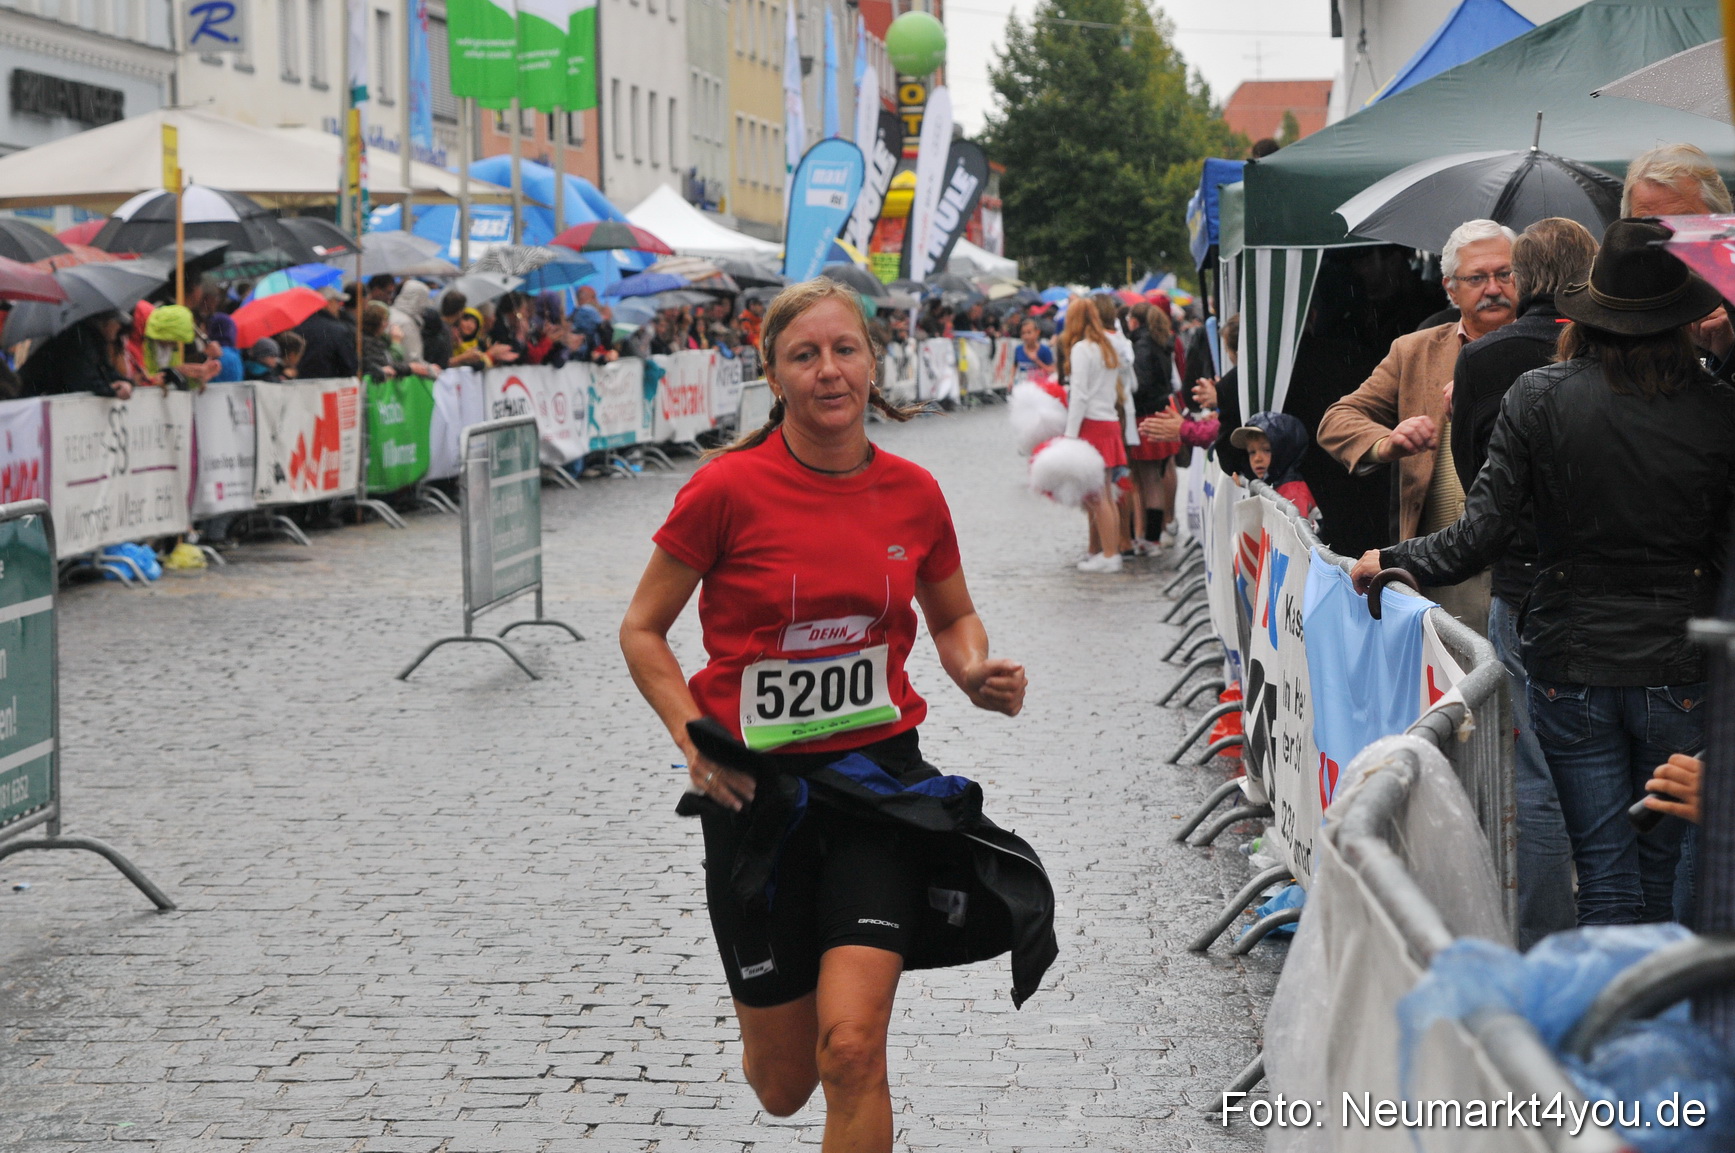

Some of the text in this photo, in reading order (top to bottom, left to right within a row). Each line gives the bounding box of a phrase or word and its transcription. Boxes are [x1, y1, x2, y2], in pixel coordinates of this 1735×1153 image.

[808, 624, 848, 641] DEHN
[756, 658, 874, 720] 5200
[857, 918, 900, 929] BROOKS
